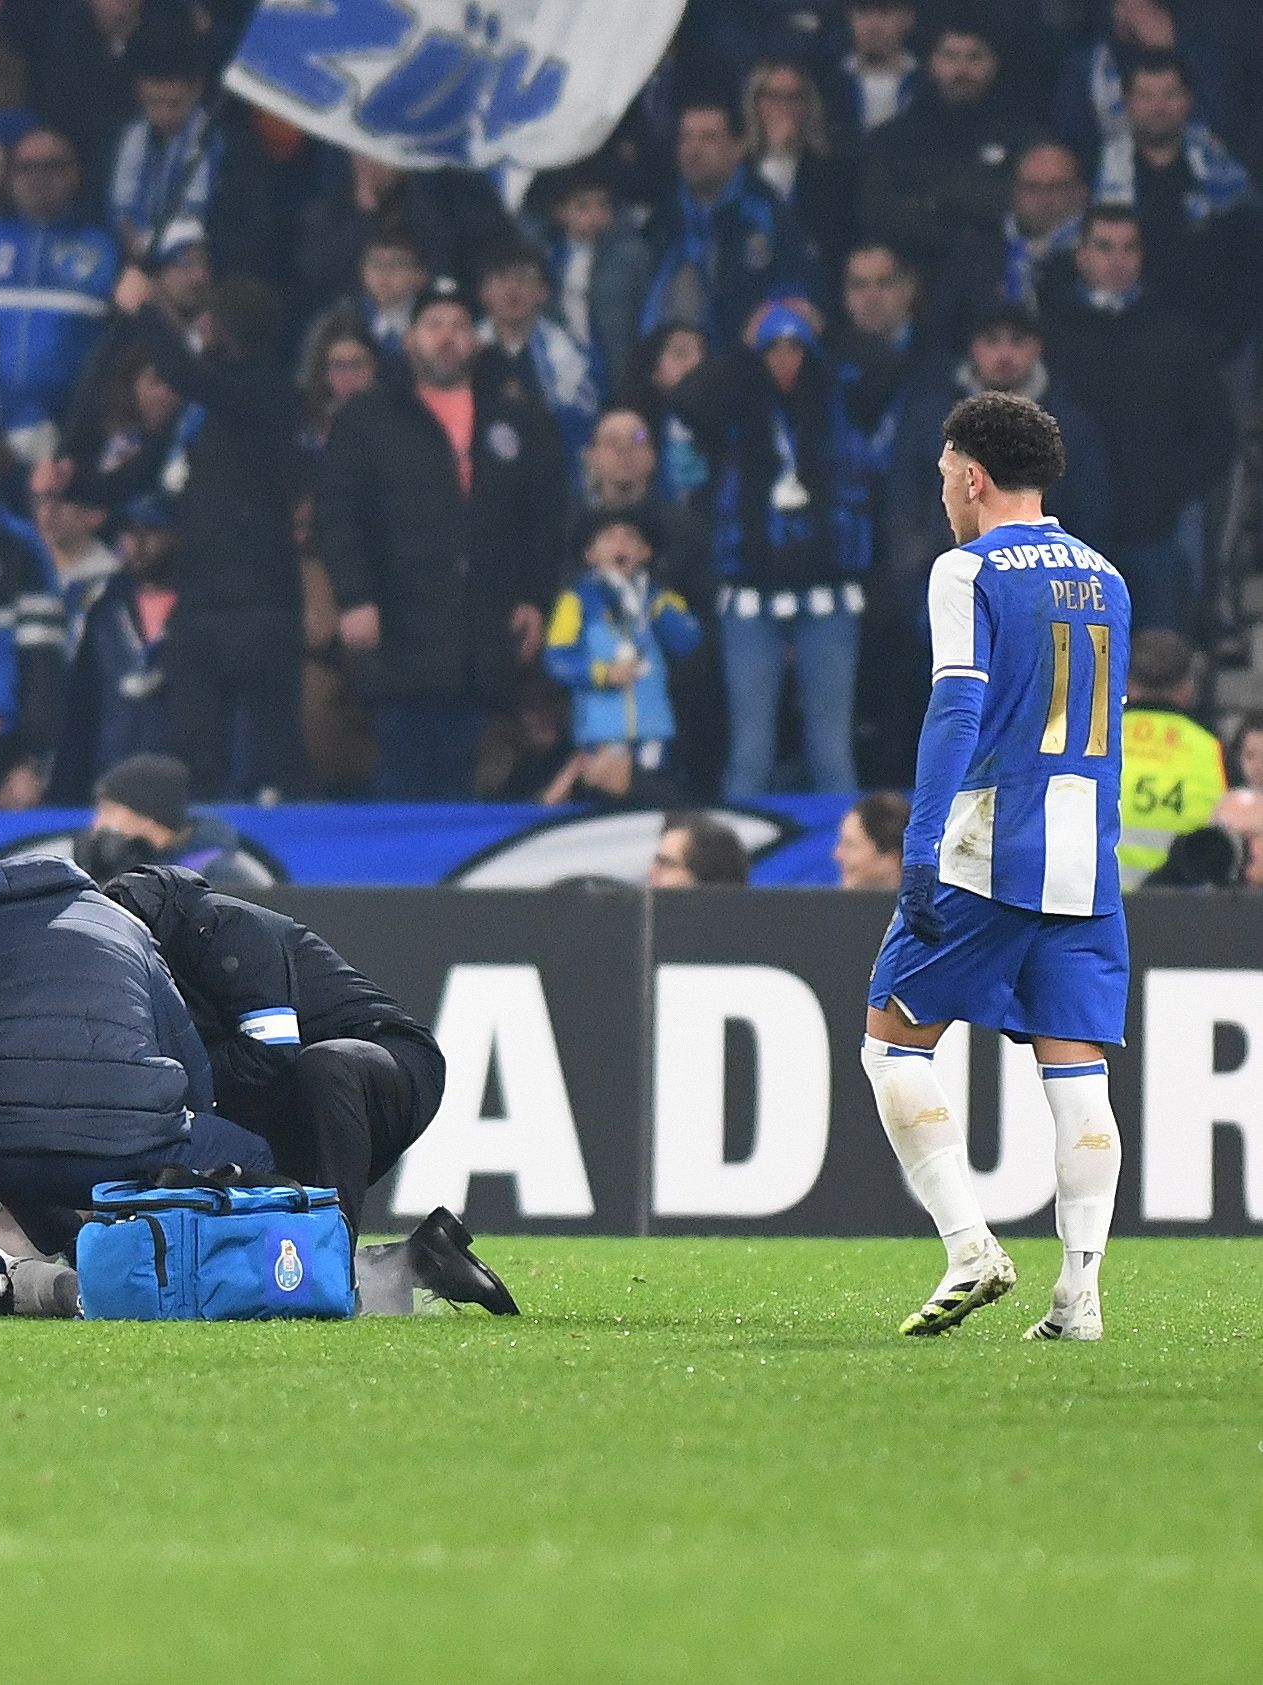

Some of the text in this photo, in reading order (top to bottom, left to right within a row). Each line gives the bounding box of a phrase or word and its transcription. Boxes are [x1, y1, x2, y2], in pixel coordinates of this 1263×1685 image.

[988, 543, 1121, 577] SUPER BOC
[1049, 574, 1105, 612] PEPÊ
[1038, 621, 1109, 757] 11
[1133, 775, 1185, 816] 54
